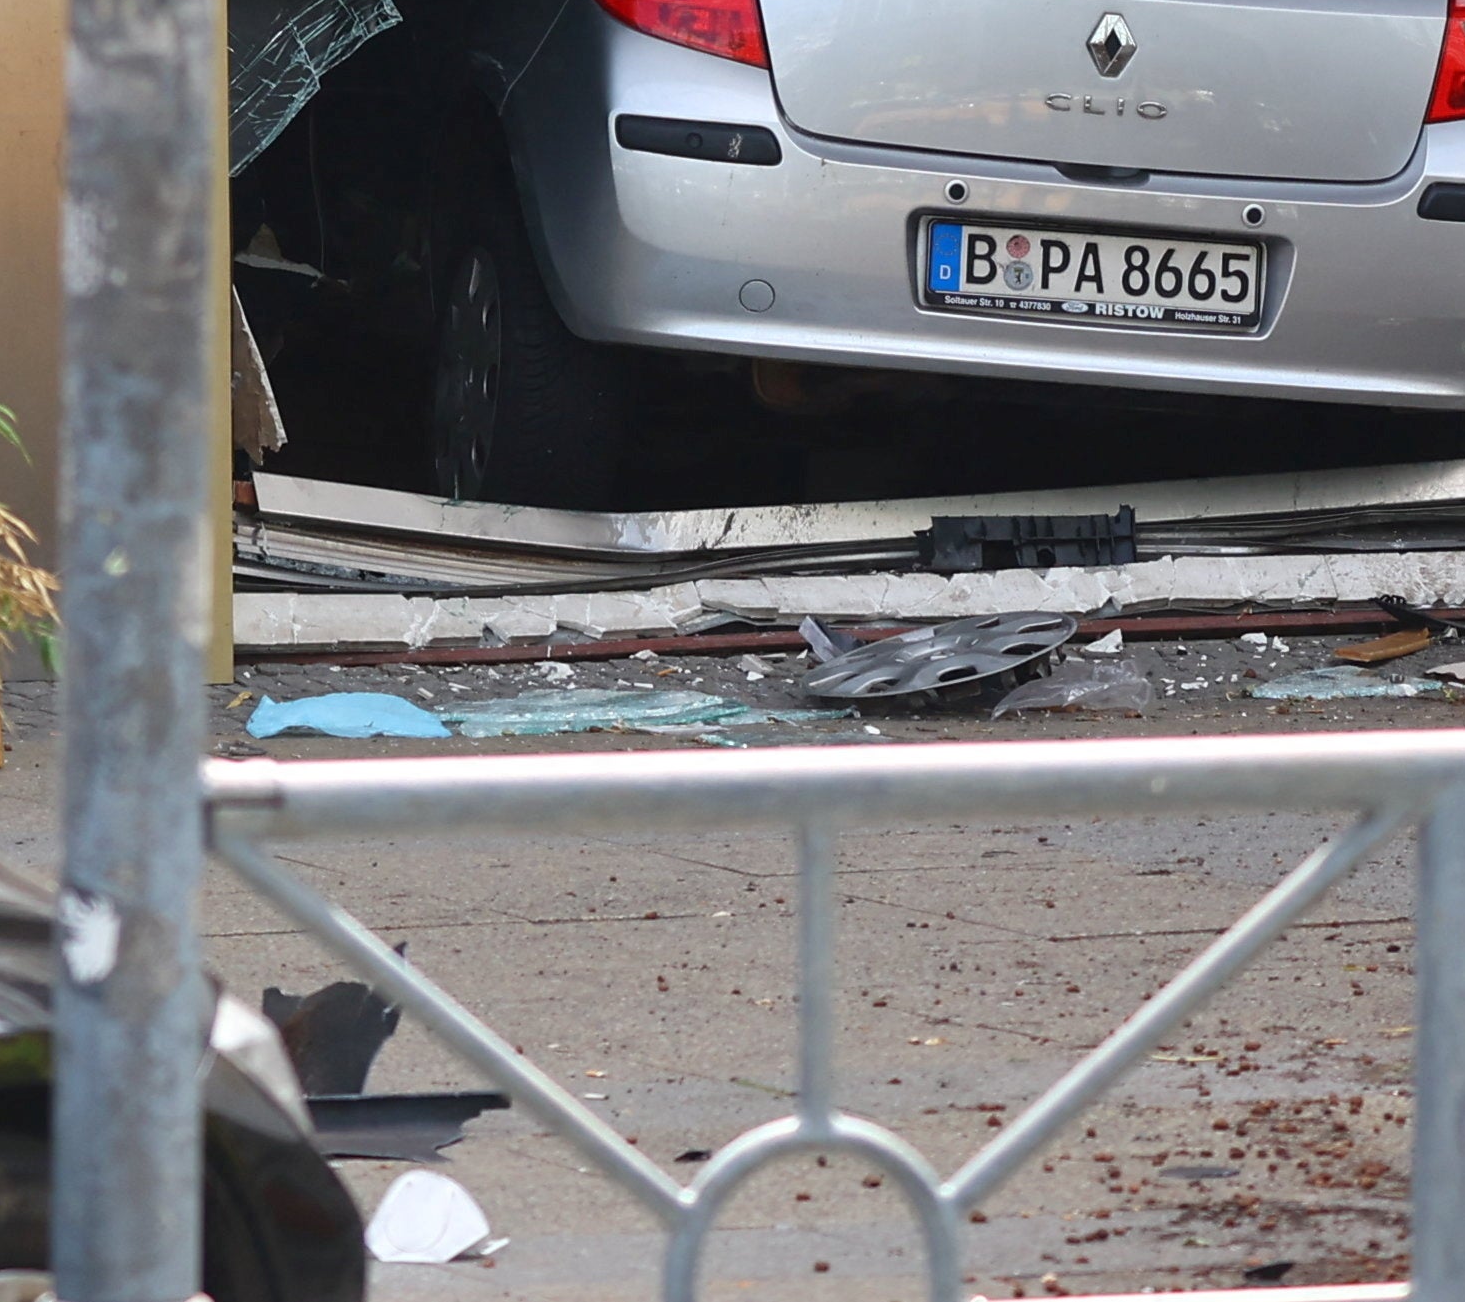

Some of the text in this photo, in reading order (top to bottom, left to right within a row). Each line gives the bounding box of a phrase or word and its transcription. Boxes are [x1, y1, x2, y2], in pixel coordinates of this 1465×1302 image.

[1044, 92, 1168, 119] CLIO
[939, 266, 951, 280] D
[966, 234, 1252, 304] B PA 8665
[979, 297, 993, 307] Str.
[995, 298, 1005, 308] 10
[1095, 304, 1165, 320] RISTOW
[1175, 311, 1242, 325] Holzhauser Str. 31
